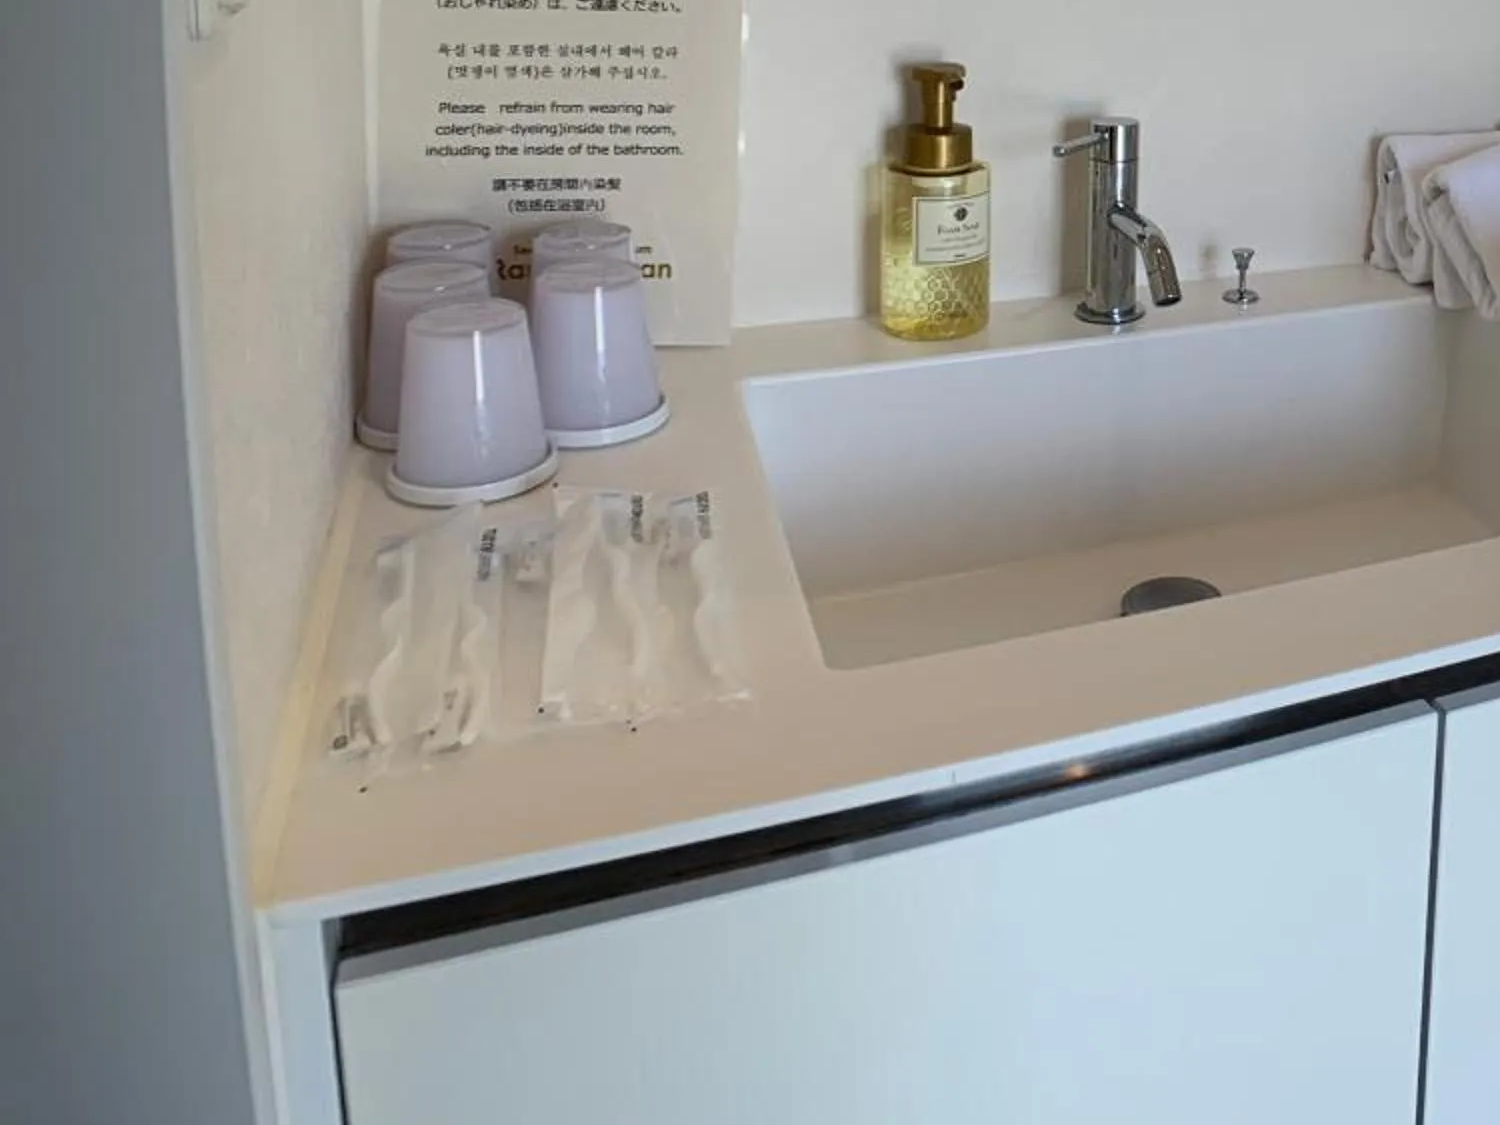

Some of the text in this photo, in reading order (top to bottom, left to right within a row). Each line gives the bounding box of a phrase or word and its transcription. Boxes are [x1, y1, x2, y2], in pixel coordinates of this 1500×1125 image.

[438, 99, 675, 117] Please refrain from wearing hair
[608, 122, 632, 135] the
[635, 124, 676, 137] room,
[425, 142, 684, 159] including the inside of the bathroom.
